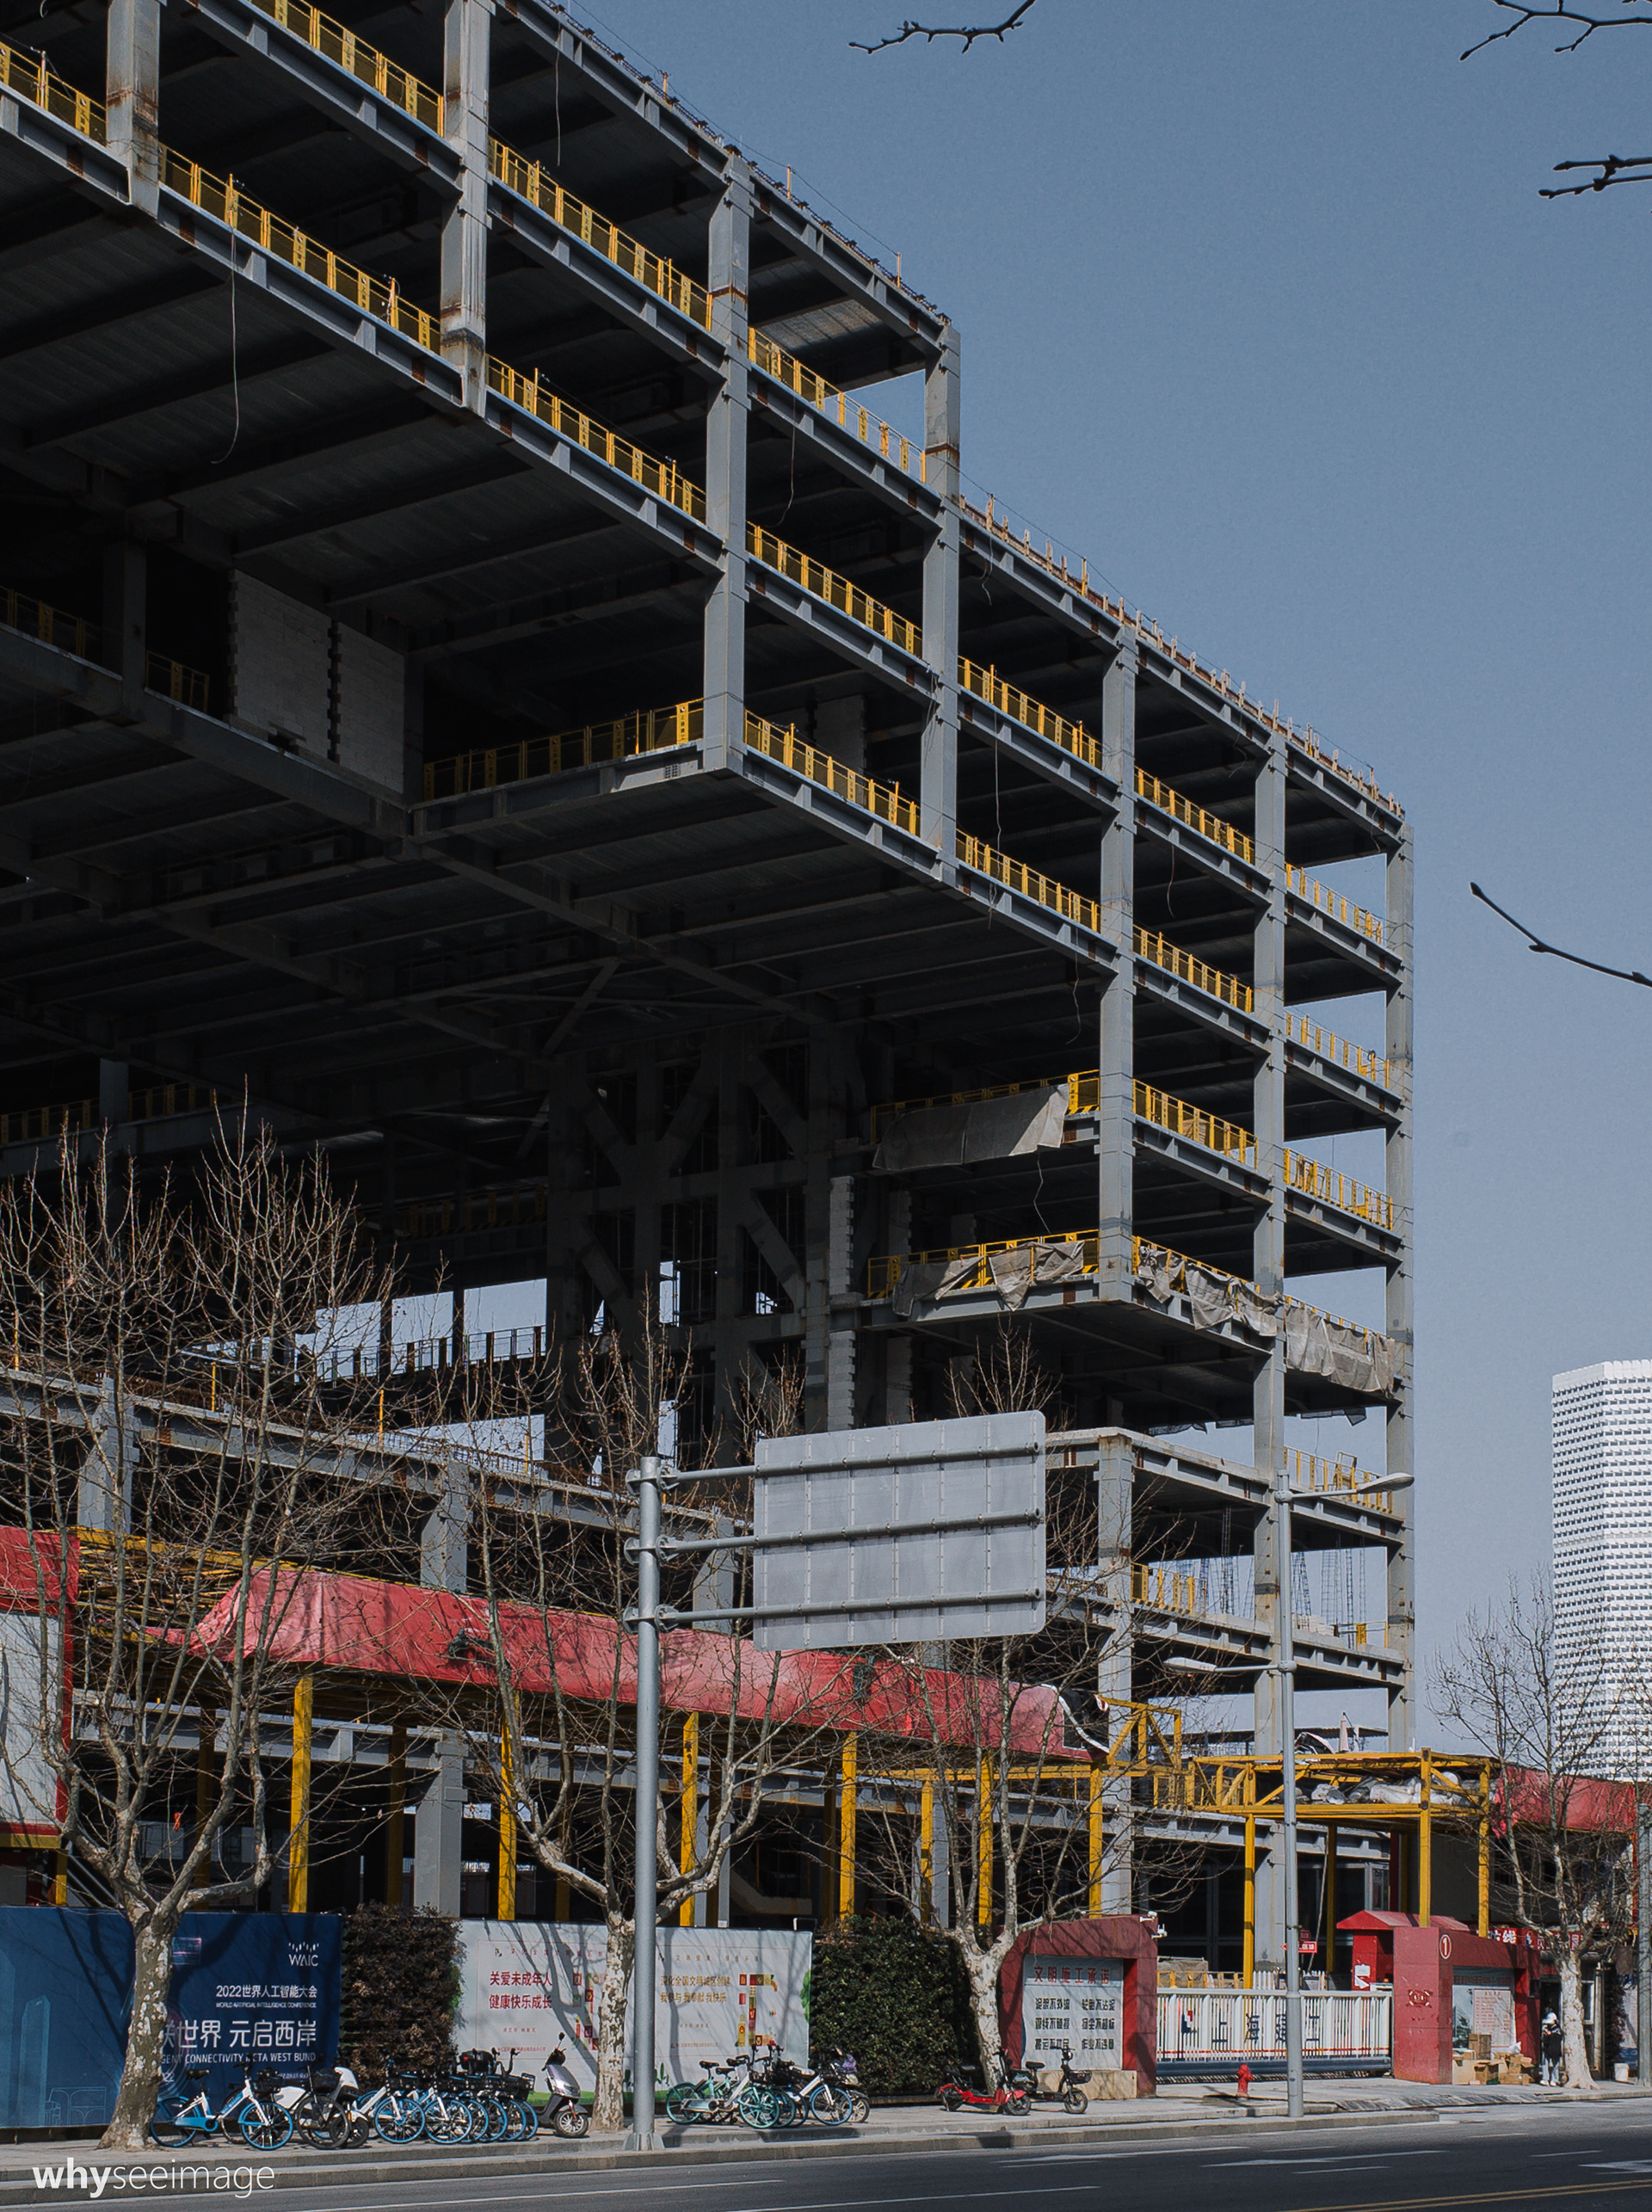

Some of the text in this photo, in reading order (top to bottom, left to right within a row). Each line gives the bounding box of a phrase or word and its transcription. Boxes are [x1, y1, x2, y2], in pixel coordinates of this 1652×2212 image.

[288, 1954, 319, 1967] WAIC
[490, 1971, 552, 1986] 关爱未成年人
[1033, 1966, 1110, 1984] 文明施工承诺
[215, 1984, 318, 1998] 2022世界人工智能大会
[489, 1994, 552, 2009] 健康快乐成长
[229, 2019, 317, 2048] 元启西岸
[185, 2053, 243, 2064] CONNECTIVITY
[270, 2052, 293, 2062] WEST
[294, 2052, 317, 2062] BUND
